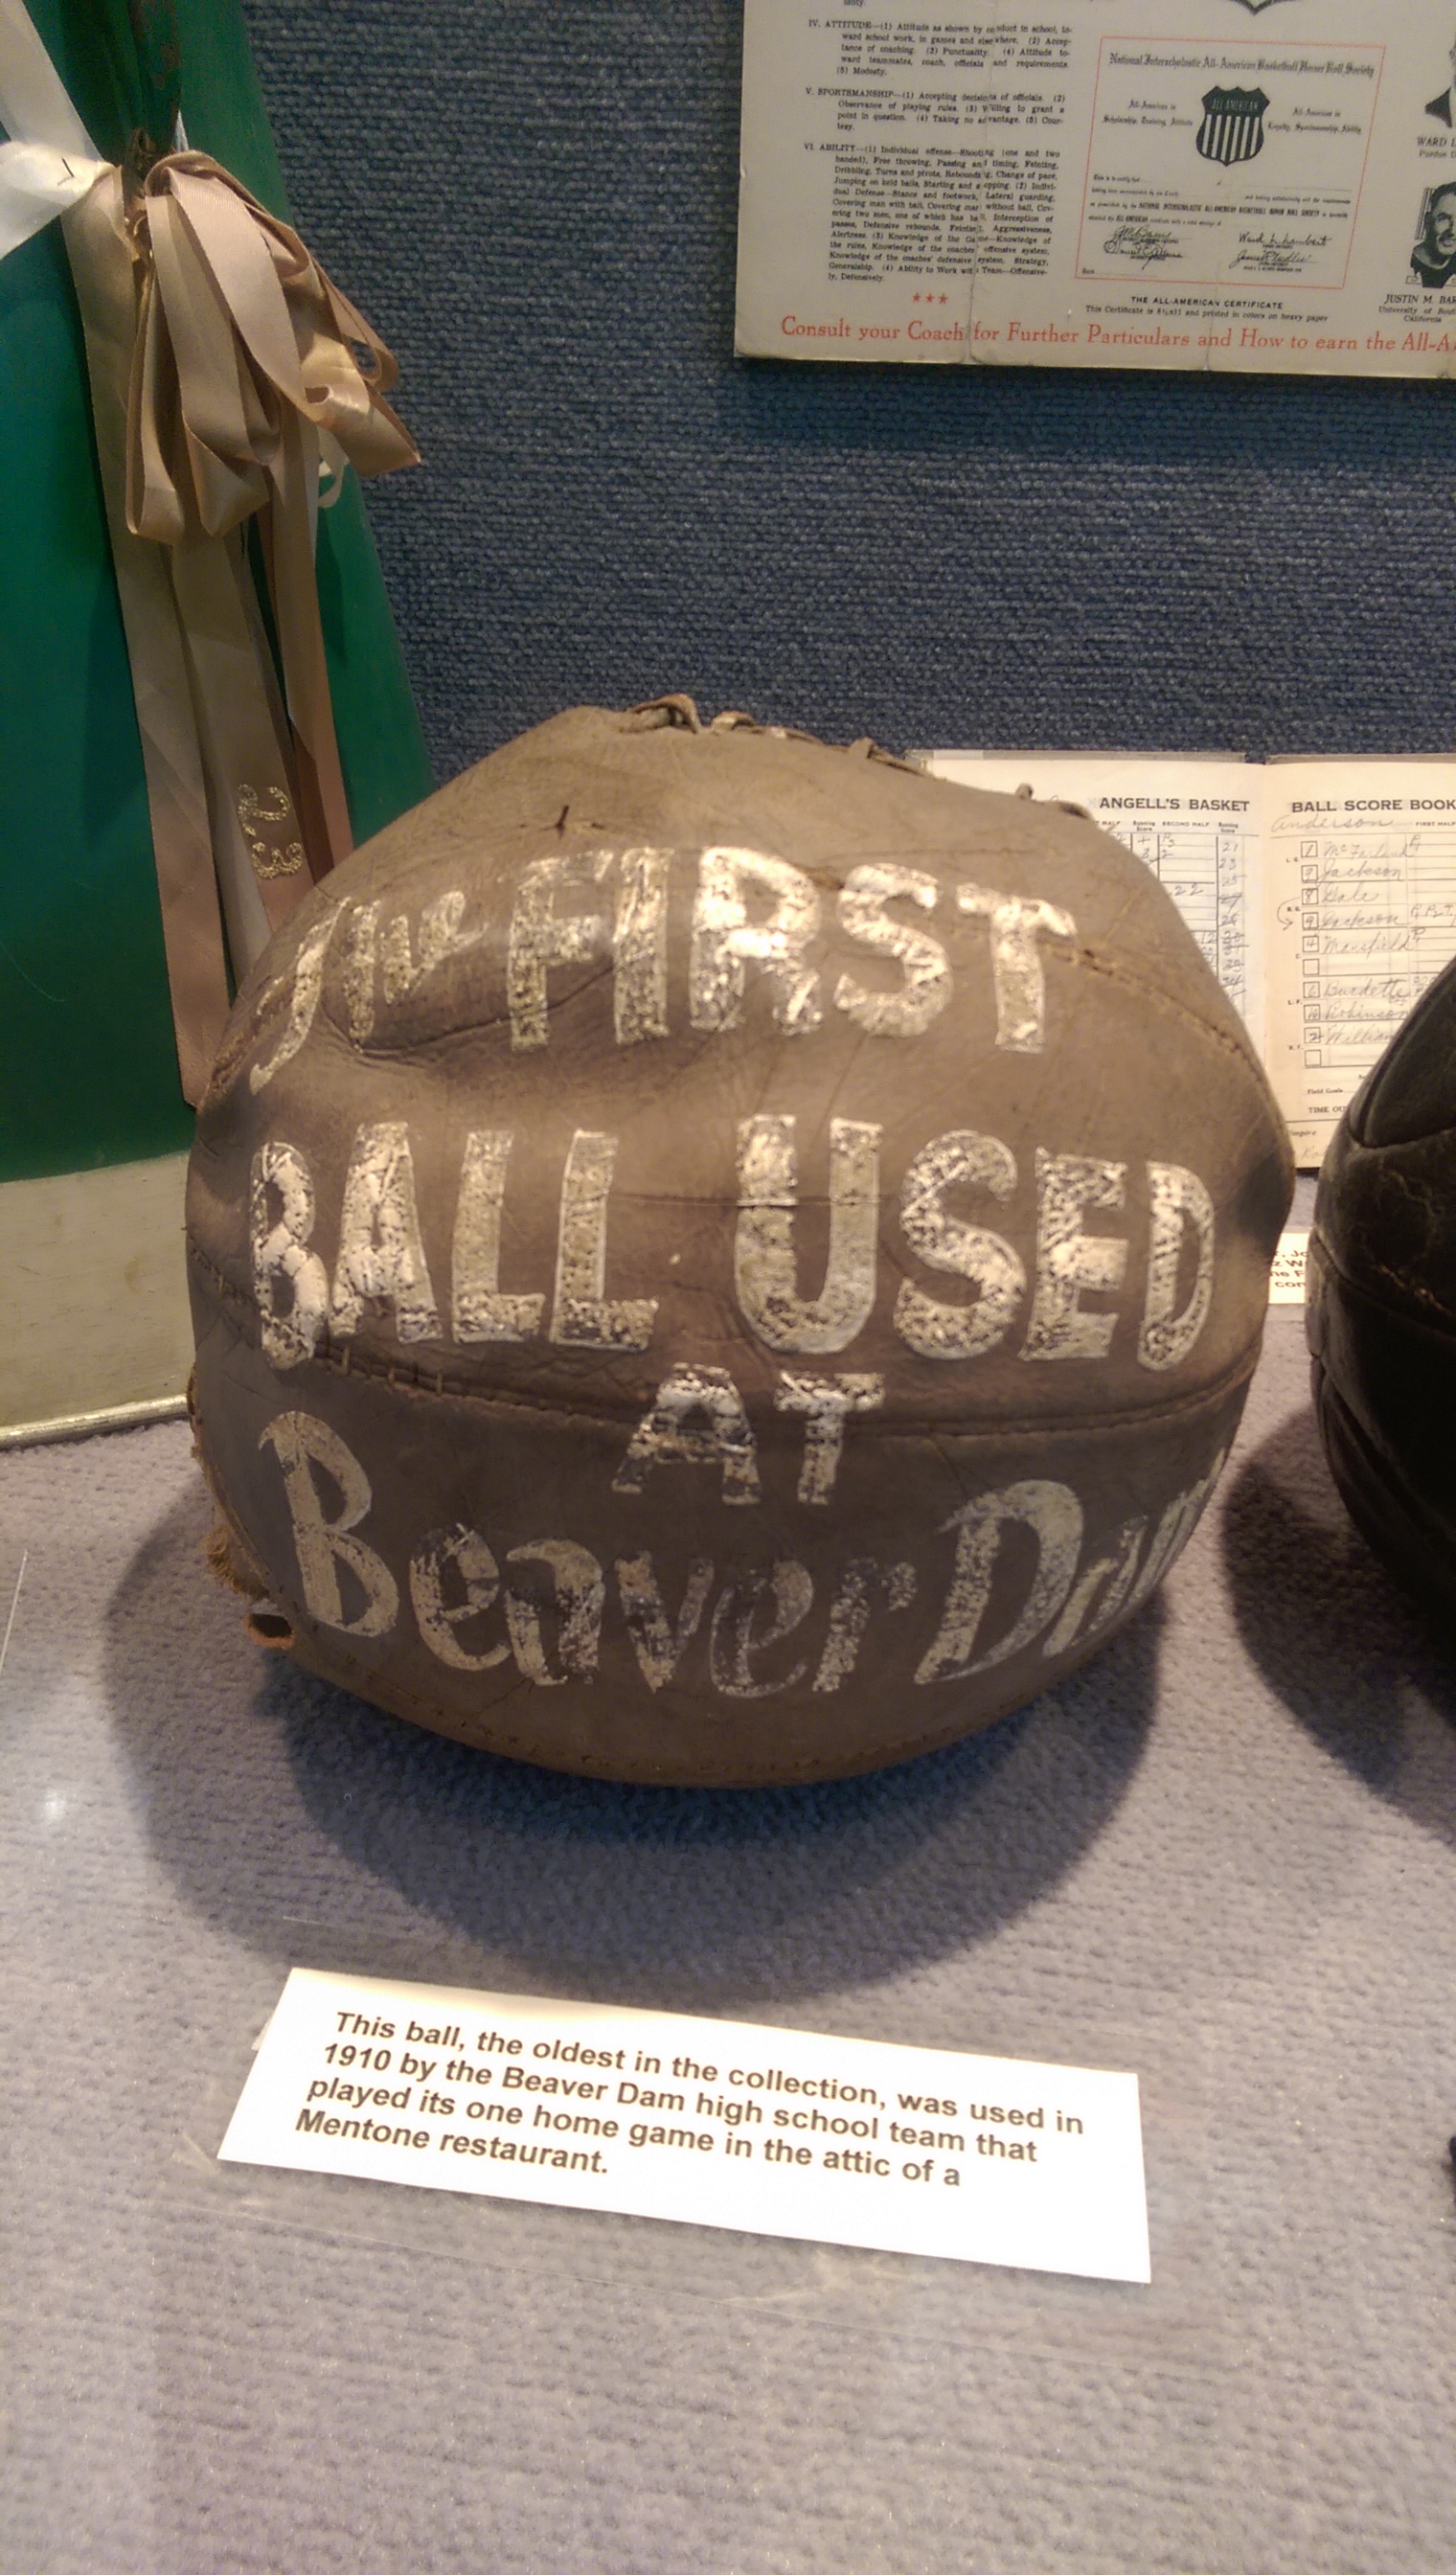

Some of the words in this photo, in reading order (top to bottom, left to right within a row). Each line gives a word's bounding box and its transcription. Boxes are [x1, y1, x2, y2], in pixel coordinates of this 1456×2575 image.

[897, 22, 929, 31] Attitude
[930, 36, 956, 45] games
[920, 92, 958, 103] Accepting
[838, 100, 883, 109] Observance
[902, 103, 931, 113] playing
[1032, 105, 1054, 114] grant
[838, 112, 857, 121] point
[933, 114, 960, 125] Taking
[1417, 136, 1447, 147] WARD
[880, 145, 920, 154] Individual
[875, 167, 899, 175] Turns
[993, 214, 1040, 223] Interception
[863, 221, 900, 230] Defensive
[888, 232, 929, 243] Knowledge
[872, 242, 913, 253] Knowledge
[830, 251, 871, 262] Knowledge
[1152, 297, 1220, 308] ALL-AMERICAN
[1224, 300, 1284, 309] CERTIFICATE
[1383, 293, 1419, 305] JUSTIN
[1085, 305, 1102, 313] This
[1104, 305, 1144, 314] Certificate
[1202, 309, 1230, 319] printed
[1281, 312, 1304, 322] heavy
[1307, 314, 1329, 324] paper
[1378, 306, 1419, 315] University
[1403, 314, 1443, 324] California
[782, 315, 852, 337] Consult
[858, 326, 900, 341] your
[907, 319, 963, 341] Coach
[972, 320, 1000, 341] for
[1007, 321, 1080, 343] Further
[1087, 323, 1191, 346] Particulars
[1197, 327, 1233, 347] and
[1239, 327, 1285, 347] How
[1290, 335, 1308, 349] to
[1315, 337, 1358, 350] earn
[1367, 330, 1397, 350] the
[1099, 797, 1181, 811] ANGELL'S
[1188, 798, 1250, 812] BASKET
[1292, 801, 1337, 813] BALL
[1344, 799, 1404, 811] SCORE
[1410, 798, 1456, 810] BOOK
[507, 845, 1078, 1052] FIRST
[249, 1121, 659, 1371] BALL
[733, 1113, 1217, 1371] USED
[611, 1361, 885, 1507] AT
[259, 1410, 918, 1698] Beaver
[335, 2011, 396, 2039] This
[405, 2019, 466, 2052] ball,
[477, 2030, 524, 2056] the
[533, 2039, 626, 2072] oldest
[634, 2050, 662, 2075] in
[671, 2056, 718, 2082] the
[729, 2068, 887, 2111] collection,
[897, 2091, 959, 2117] was
[970, 2104, 1045, 2130] used
[1056, 2109, 1084, 2134] in
[324, 2042, 392, 2072] 1910
[399, 2051, 437, 2083] by
[444, 2059, 492, 2085] the
[502, 2065, 609, 2102] Beaver
[616, 2081, 686, 2112] Dam
[695, 2092, 763, 2127] high
[773, 2108, 879, 2140] school
[889, 2120, 966, 2152] team
[976, 2134, 1038, 2163] that
[307, 2076, 412, 2110] played
[419, 2089, 456, 2116] its
[466, 2102, 524, 2126] one
[533, 2104, 620, 2138] home
[628, 2124, 715, 2152] game
[725, 2131, 753, 2158] in
[763, 2138, 813, 2167] the
[823, 2148, 891, 2177] attic
[902, 2158, 934, 2182] of
[944, 2167, 962, 2187] a
[295, 2108, 430, 2150] Mentone
[440, 2131, 609, 2175] restaurant.
